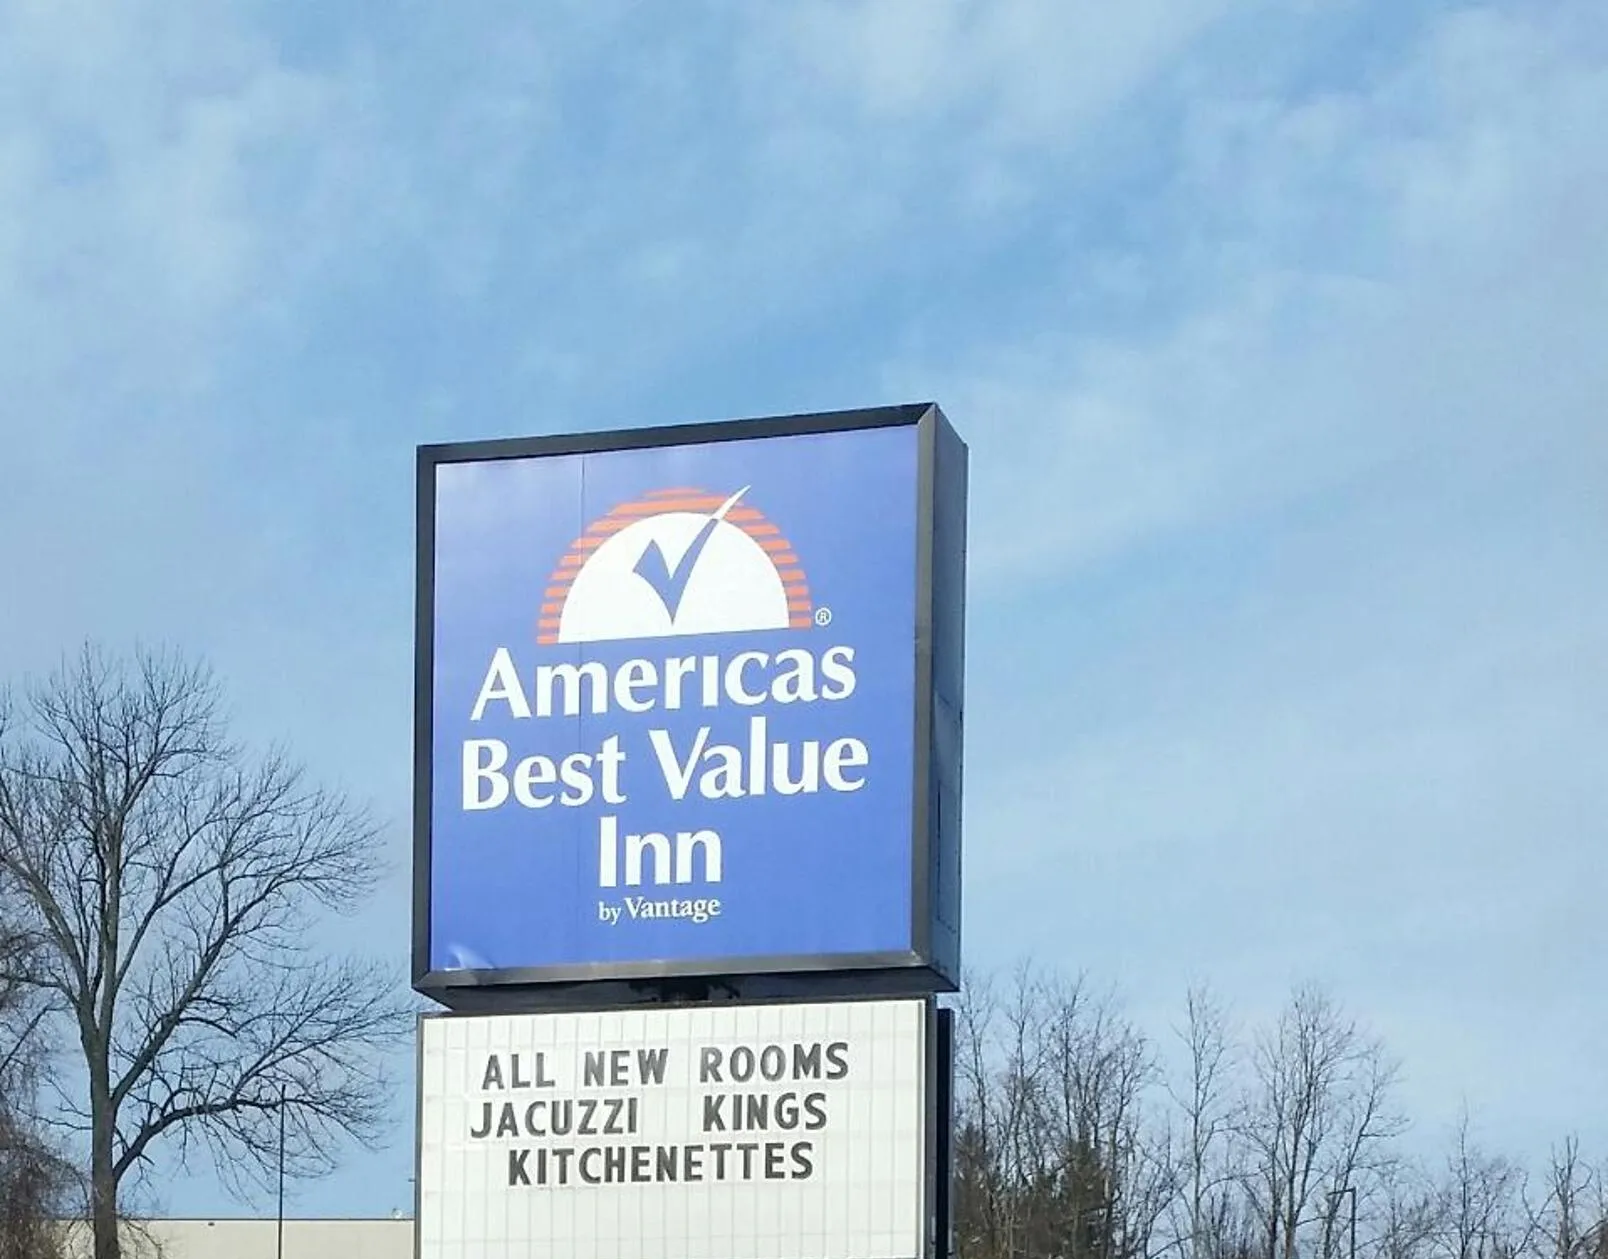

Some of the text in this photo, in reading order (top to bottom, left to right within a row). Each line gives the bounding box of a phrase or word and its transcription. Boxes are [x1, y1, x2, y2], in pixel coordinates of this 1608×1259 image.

[470, 646, 856, 721] Americas
[462, 716, 869, 811] Best Value
[599, 816, 722, 887] Inn
[599, 896, 721, 925] by Vantage
[482, 1042, 849, 1090] ALL NEW ROOMS
[470, 1093, 827, 1139] JACUZZI KINGS
[508, 1142, 813, 1186] KITCHENETTES
